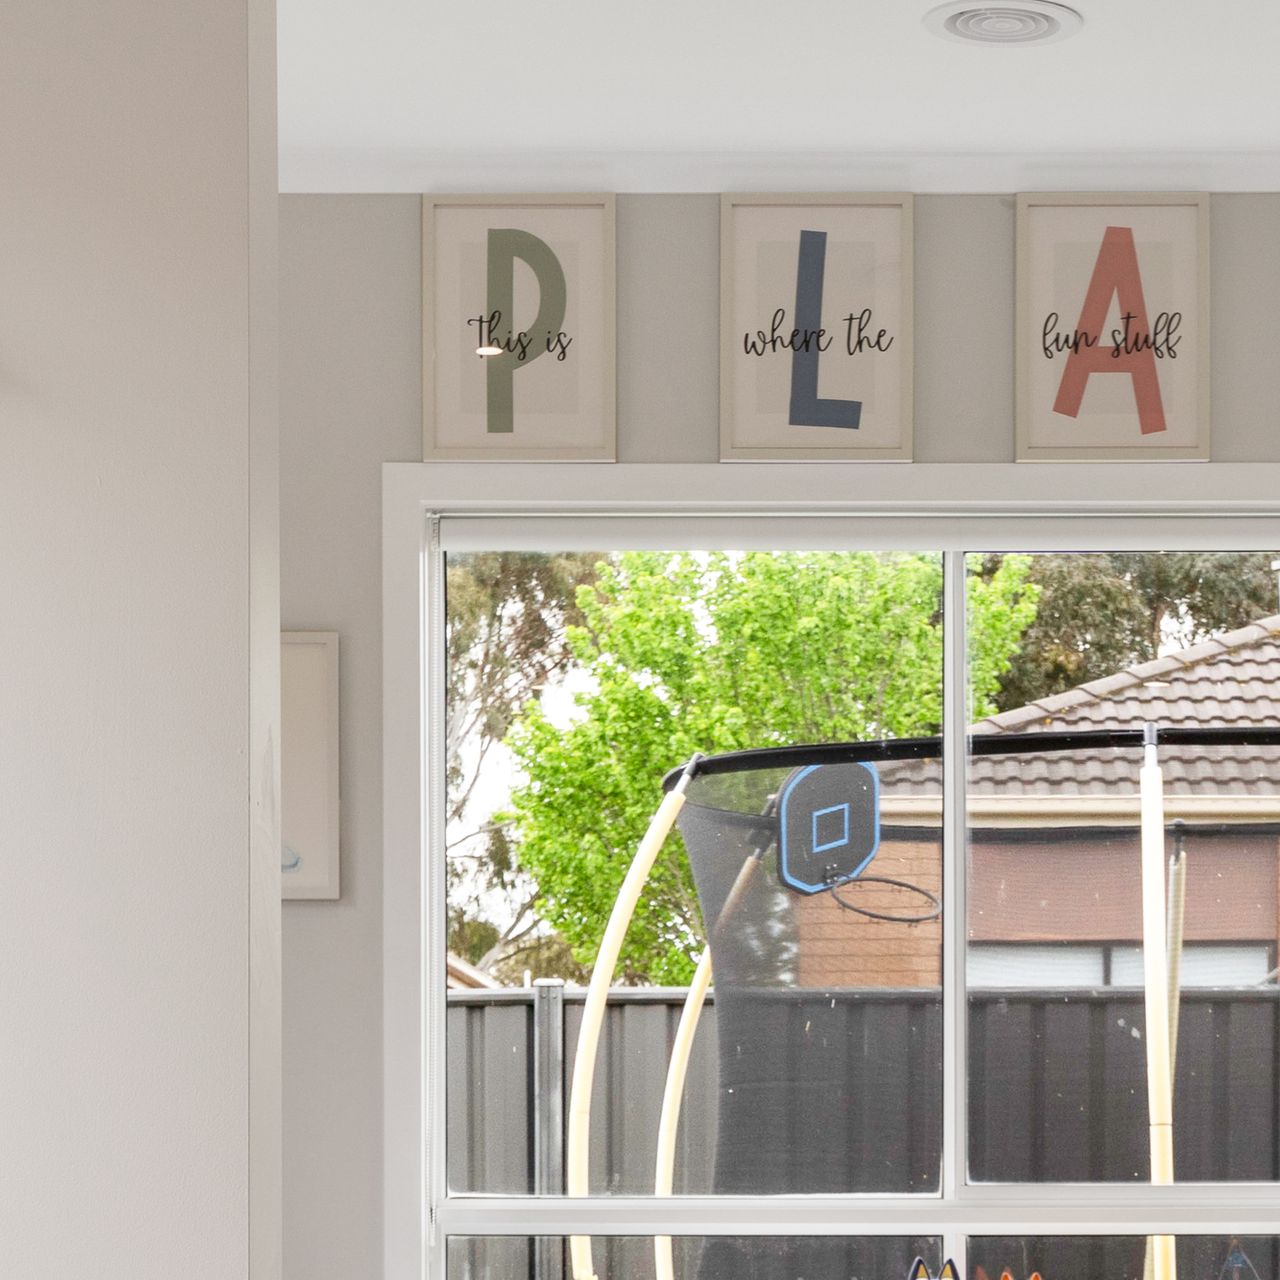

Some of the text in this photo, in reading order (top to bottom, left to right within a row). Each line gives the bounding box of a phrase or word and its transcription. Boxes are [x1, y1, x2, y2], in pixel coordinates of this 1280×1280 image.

[486, 228, 567, 433] P
[546, 328, 573, 361] is
[743, 308, 894, 357] where the
[789, 230, 863, 430] L
[1042, 311, 1182, 359] fun stuff
[1052, 226, 1168, 435] A
